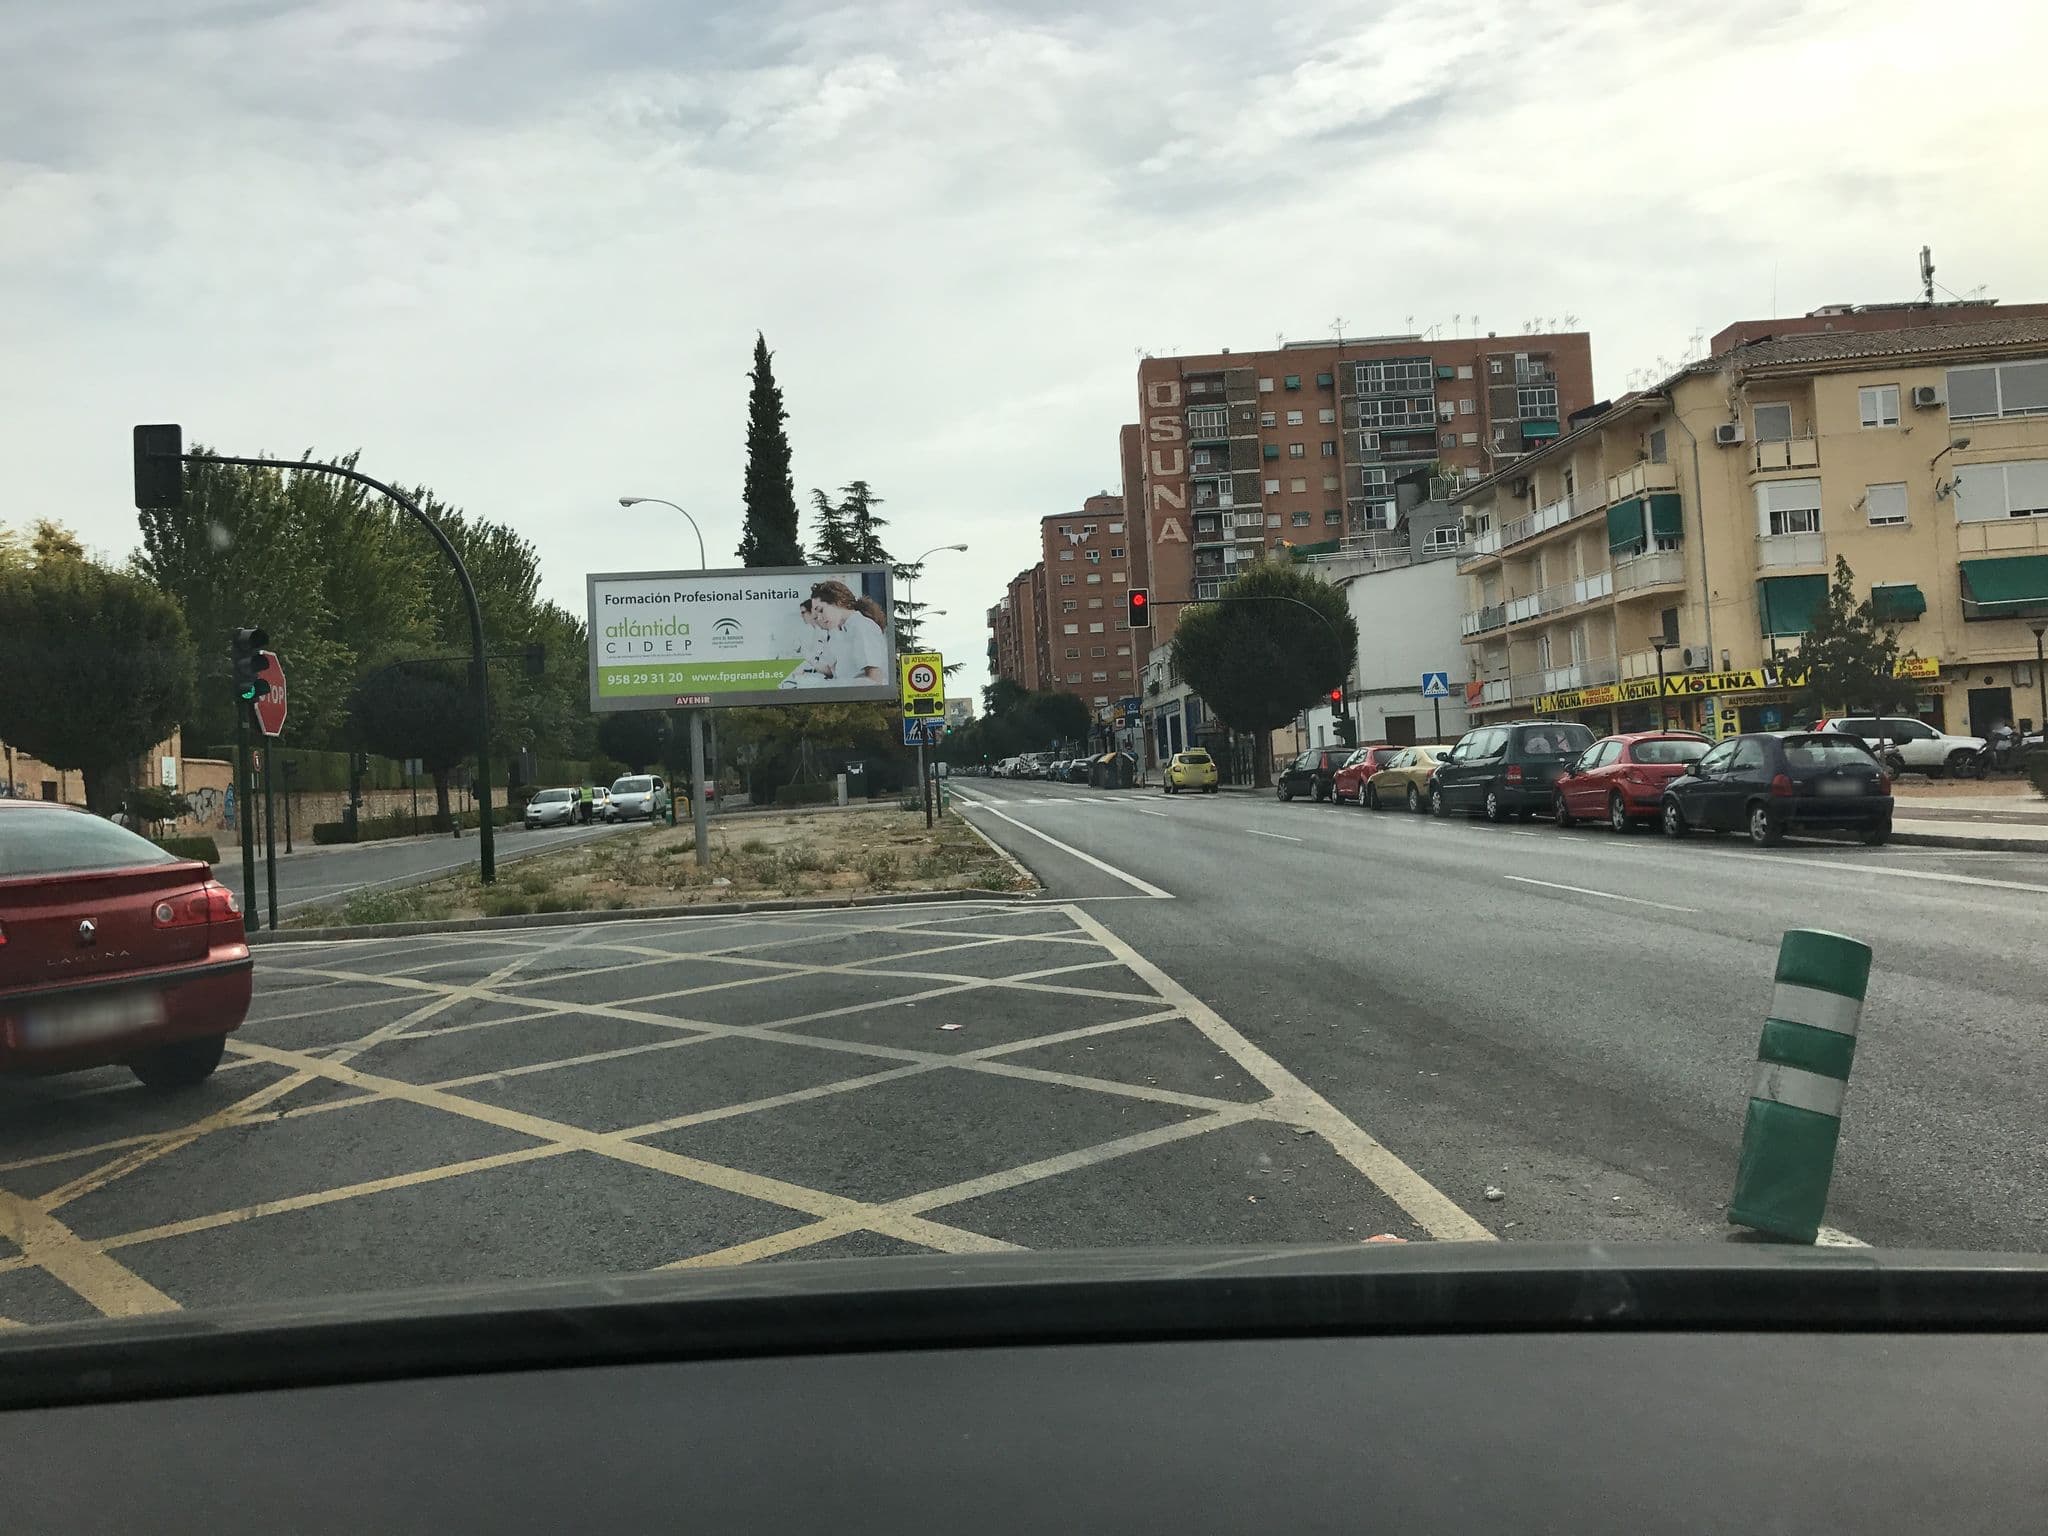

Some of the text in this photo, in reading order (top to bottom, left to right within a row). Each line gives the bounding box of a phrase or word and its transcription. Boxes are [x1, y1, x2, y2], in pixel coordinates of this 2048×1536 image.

[1148, 380, 1188, 545] OSUNA
[605, 588, 800, 606] Formación Profesional Sanitaria
[605, 615, 690, 638] atlántida
[607, 670, 784, 685] 958 29 31 20 www.fpgranada.es
[915, 673, 931, 683] 50
[1664, 674, 1757, 693] MOLINA
[676, 696, 711, 705] AVENIR
[1618, 684, 1658, 701] MOLINA
